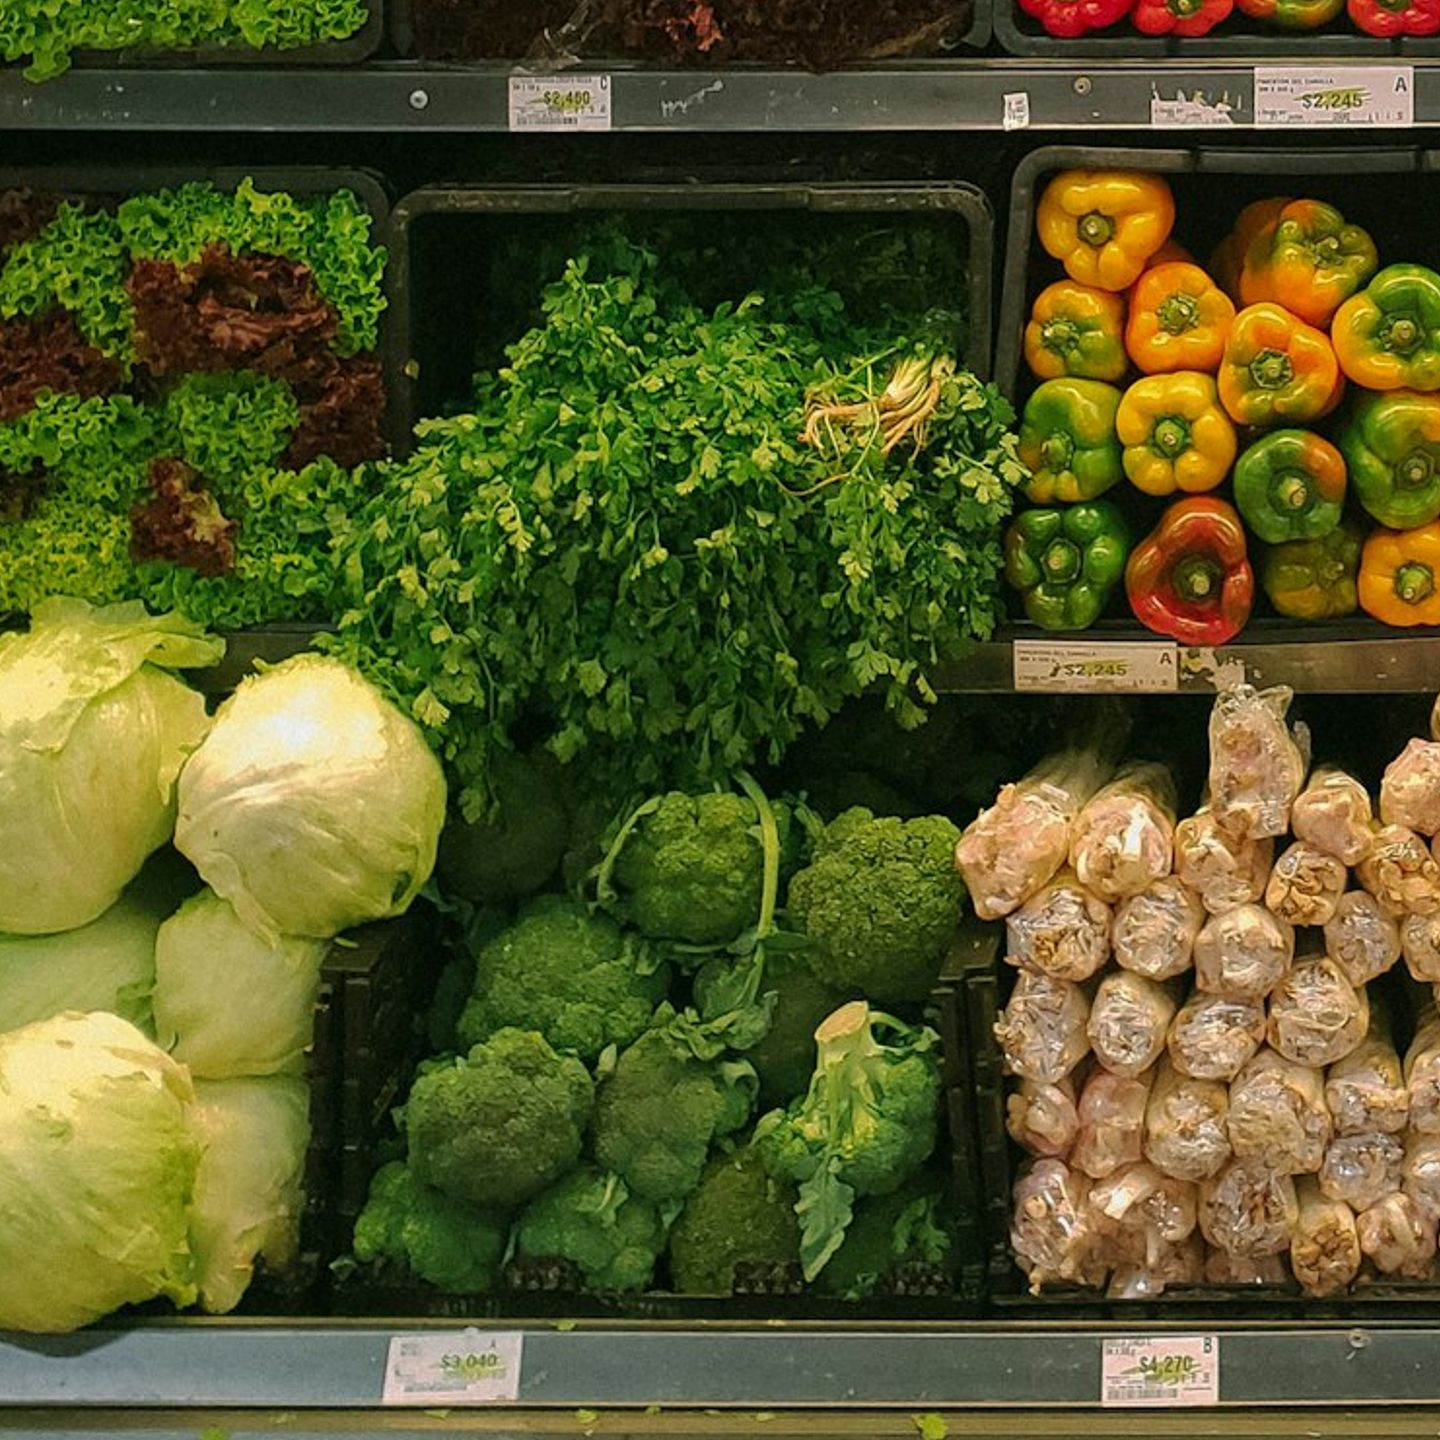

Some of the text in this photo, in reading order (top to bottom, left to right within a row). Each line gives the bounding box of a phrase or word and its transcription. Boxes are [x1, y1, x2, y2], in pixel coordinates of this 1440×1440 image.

[600, 75, 608, 91] C
[1395, 76, 1408, 93] A
[1302, 93, 1363, 111] $2,245
[1159, 652, 1173, 666] A
[1065, 662, 1128, 679] $2,245
[1203, 1336, 1213, 1354] B
[1139, 1355, 1194, 1376] $4,270
